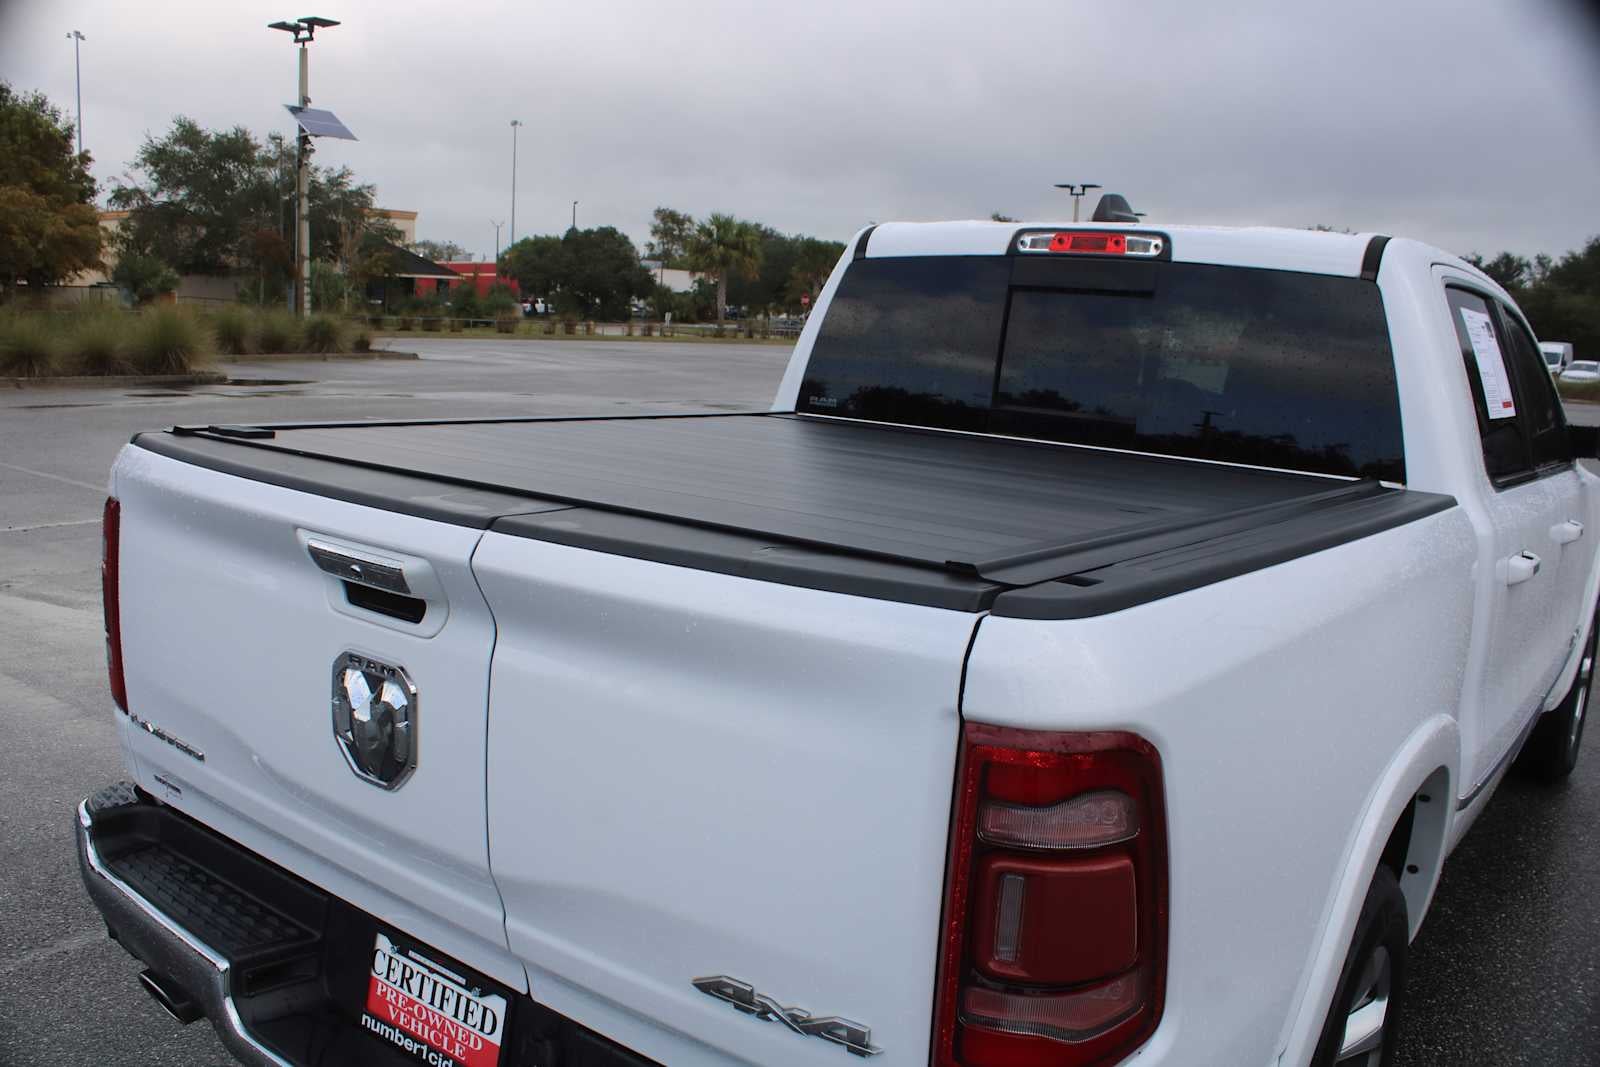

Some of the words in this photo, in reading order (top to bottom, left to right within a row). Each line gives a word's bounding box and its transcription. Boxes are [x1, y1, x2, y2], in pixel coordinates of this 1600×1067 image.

[348, 653, 397, 678] RAM
[371, 948, 498, 1036] CERTIFIED
[376, 981, 483, 1051] PRE-OWNED
[387, 1005, 467, 1061] VEHICLE
